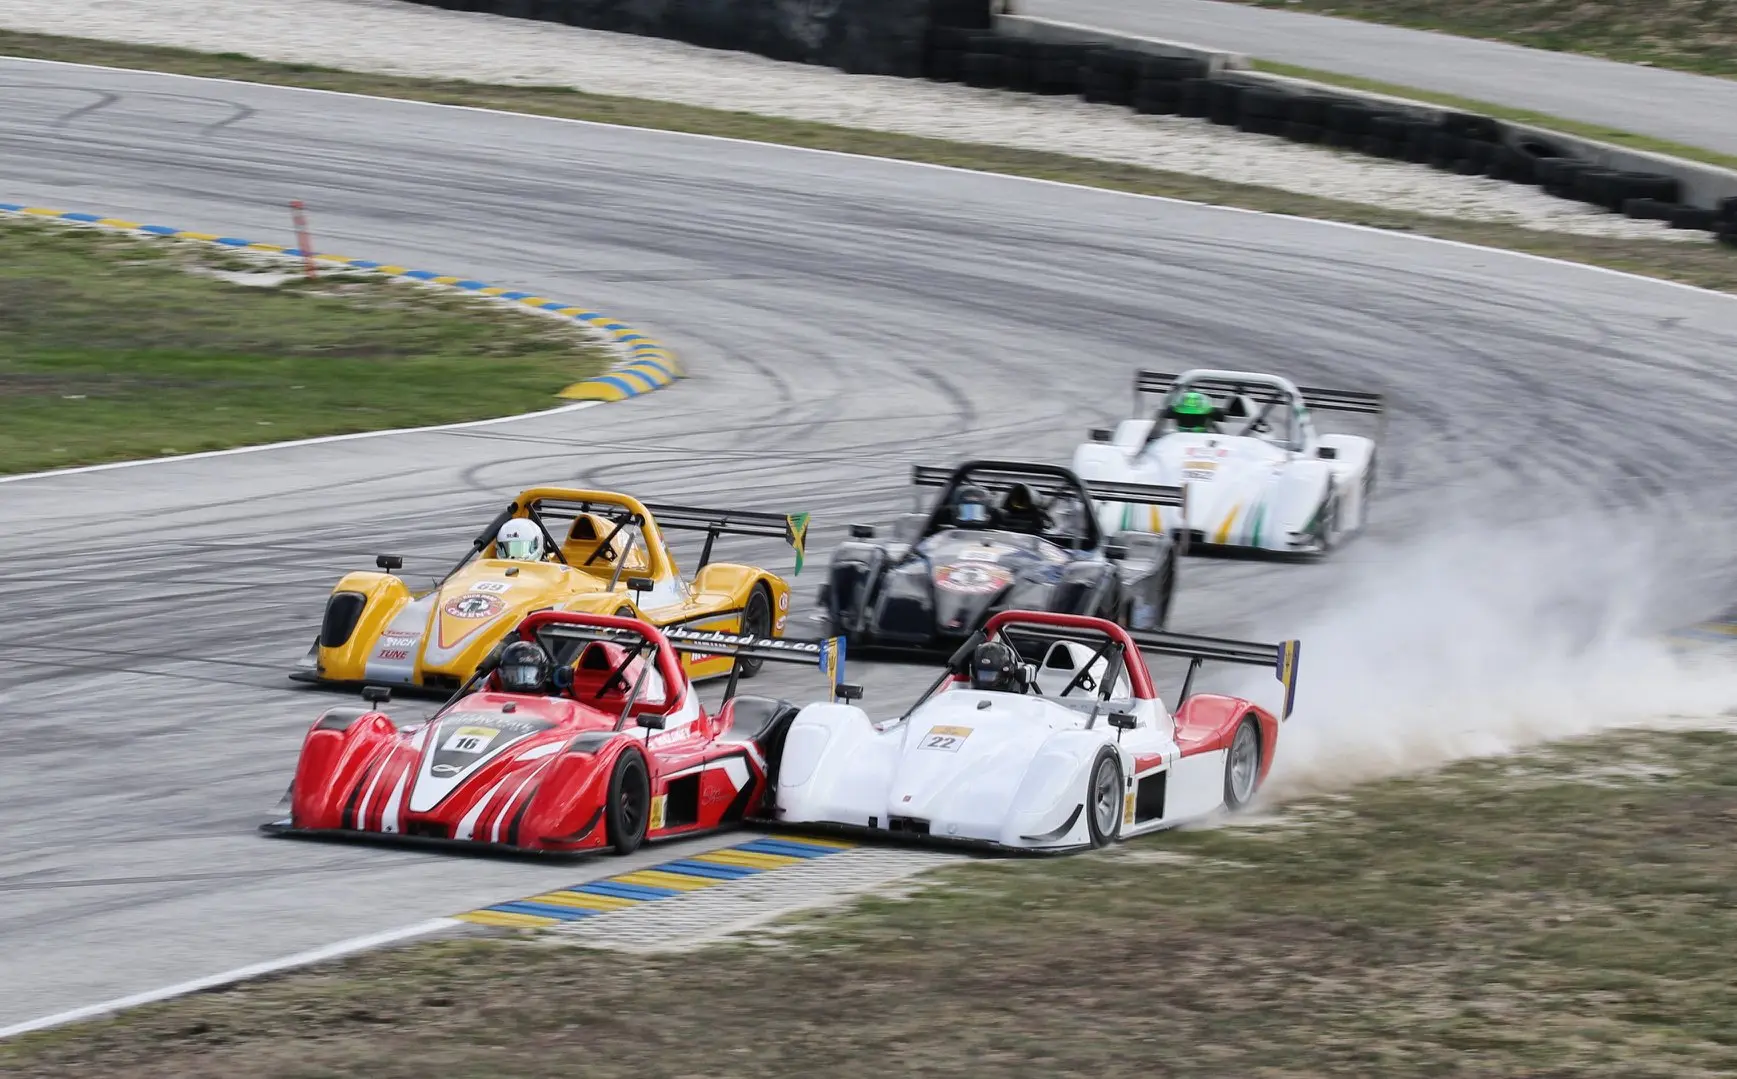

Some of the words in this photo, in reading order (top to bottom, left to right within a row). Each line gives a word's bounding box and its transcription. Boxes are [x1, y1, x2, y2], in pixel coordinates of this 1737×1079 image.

[476, 582, 505, 592] 69
[454, 737, 480, 750] 16
[927, 736, 957, 749] 22
